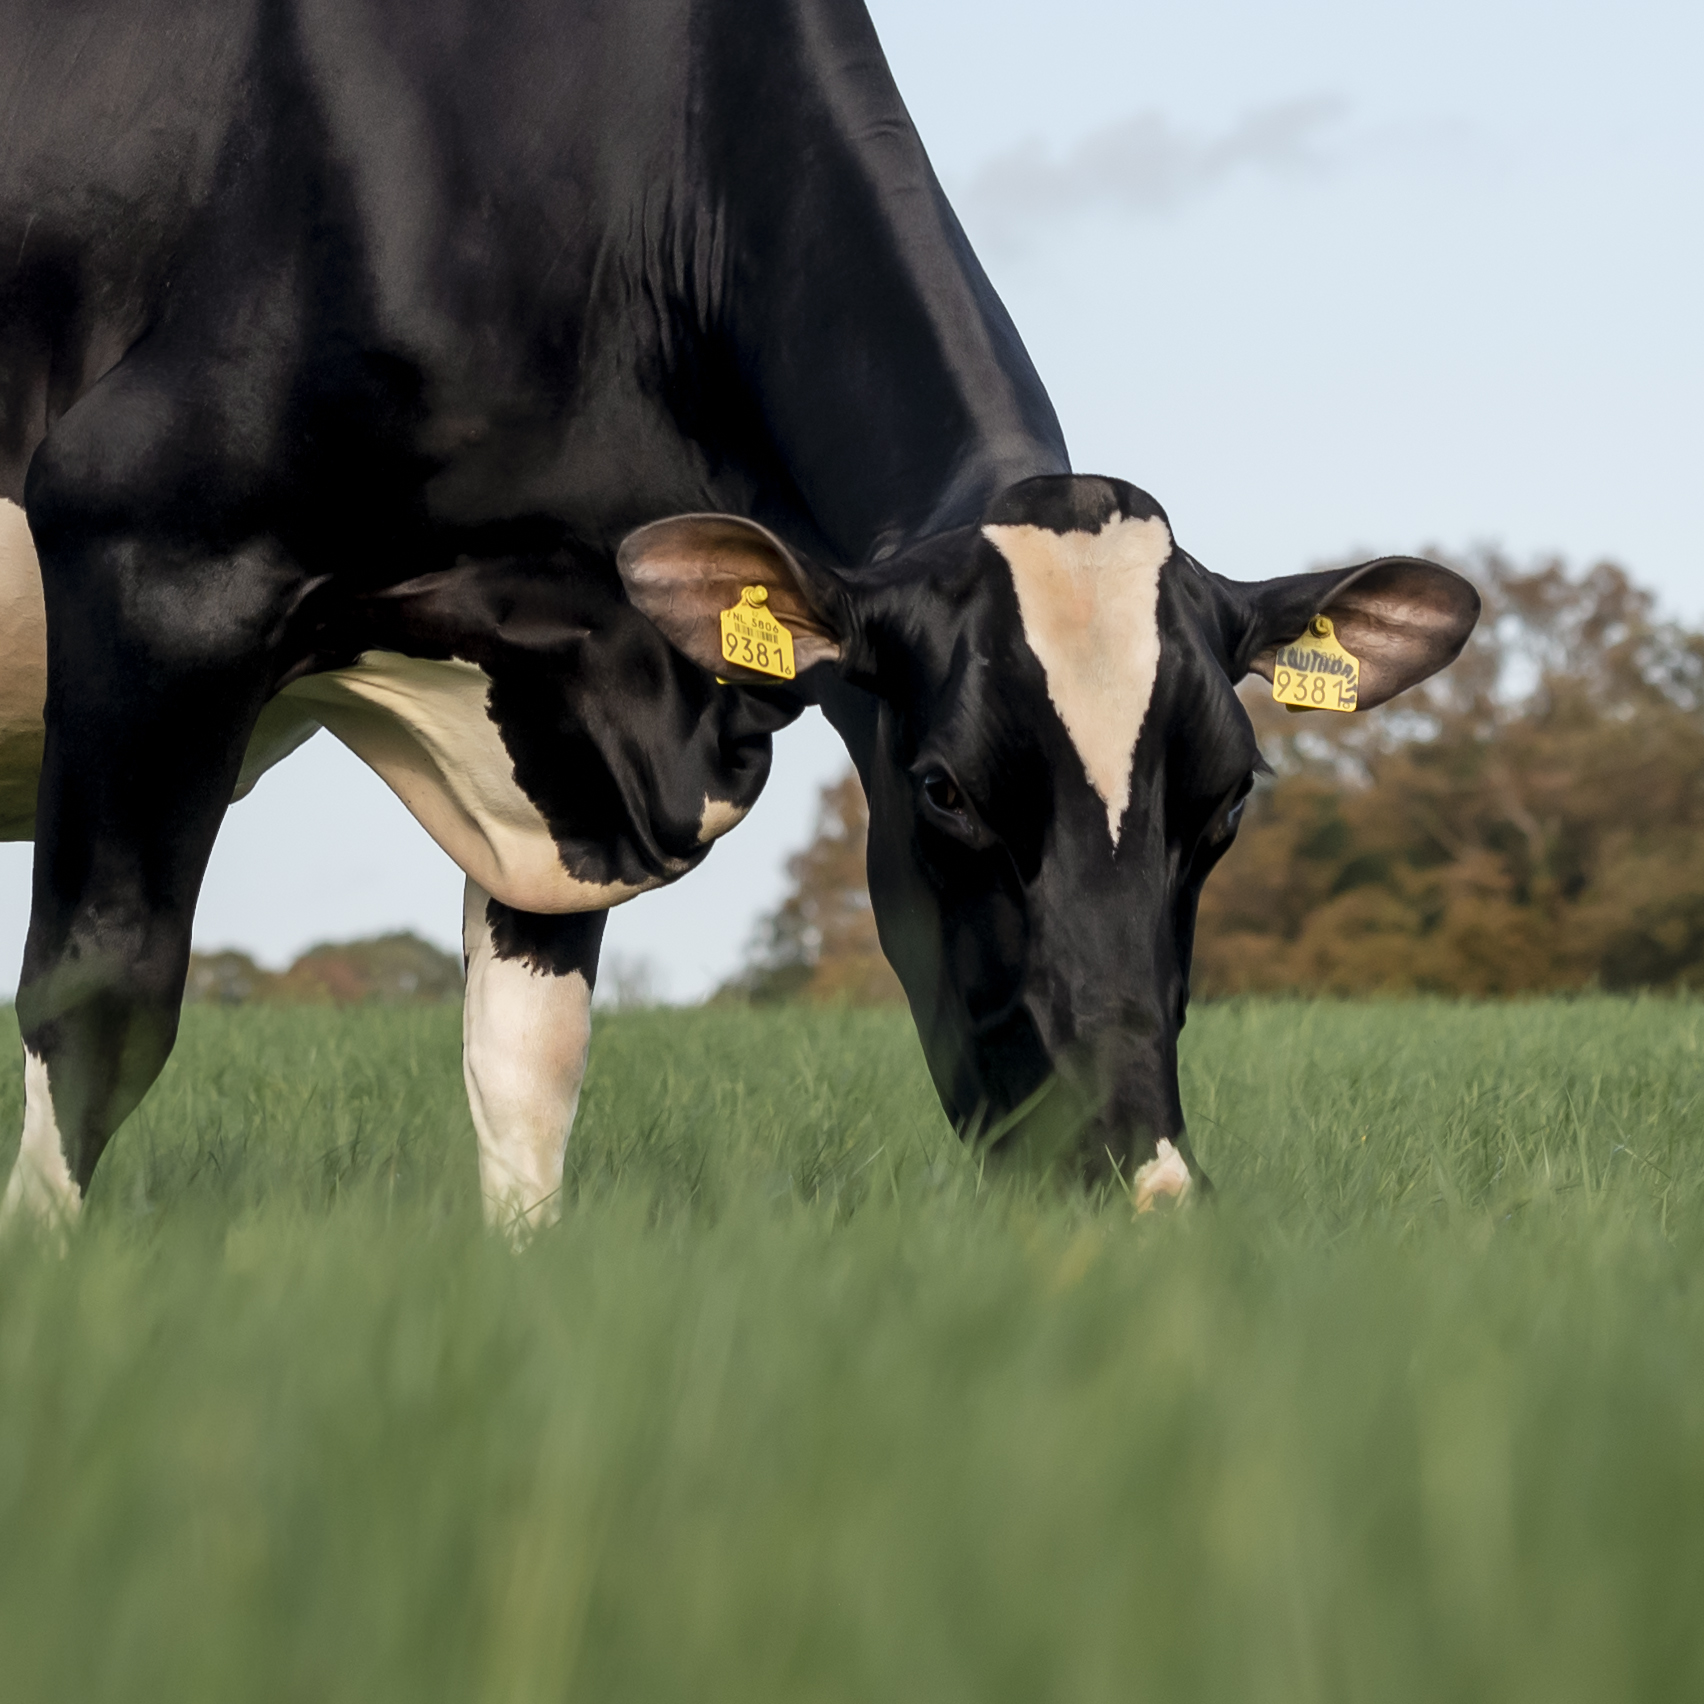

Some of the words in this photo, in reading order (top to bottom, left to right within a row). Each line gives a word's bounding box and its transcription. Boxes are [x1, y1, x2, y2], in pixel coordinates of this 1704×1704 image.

[733, 612, 747, 625] NL
[752, 618, 779, 633] 5806
[726, 633, 783, 673] 9381
[784, 665, 792, 675] 6
[1277, 670, 1344, 708] 9381
